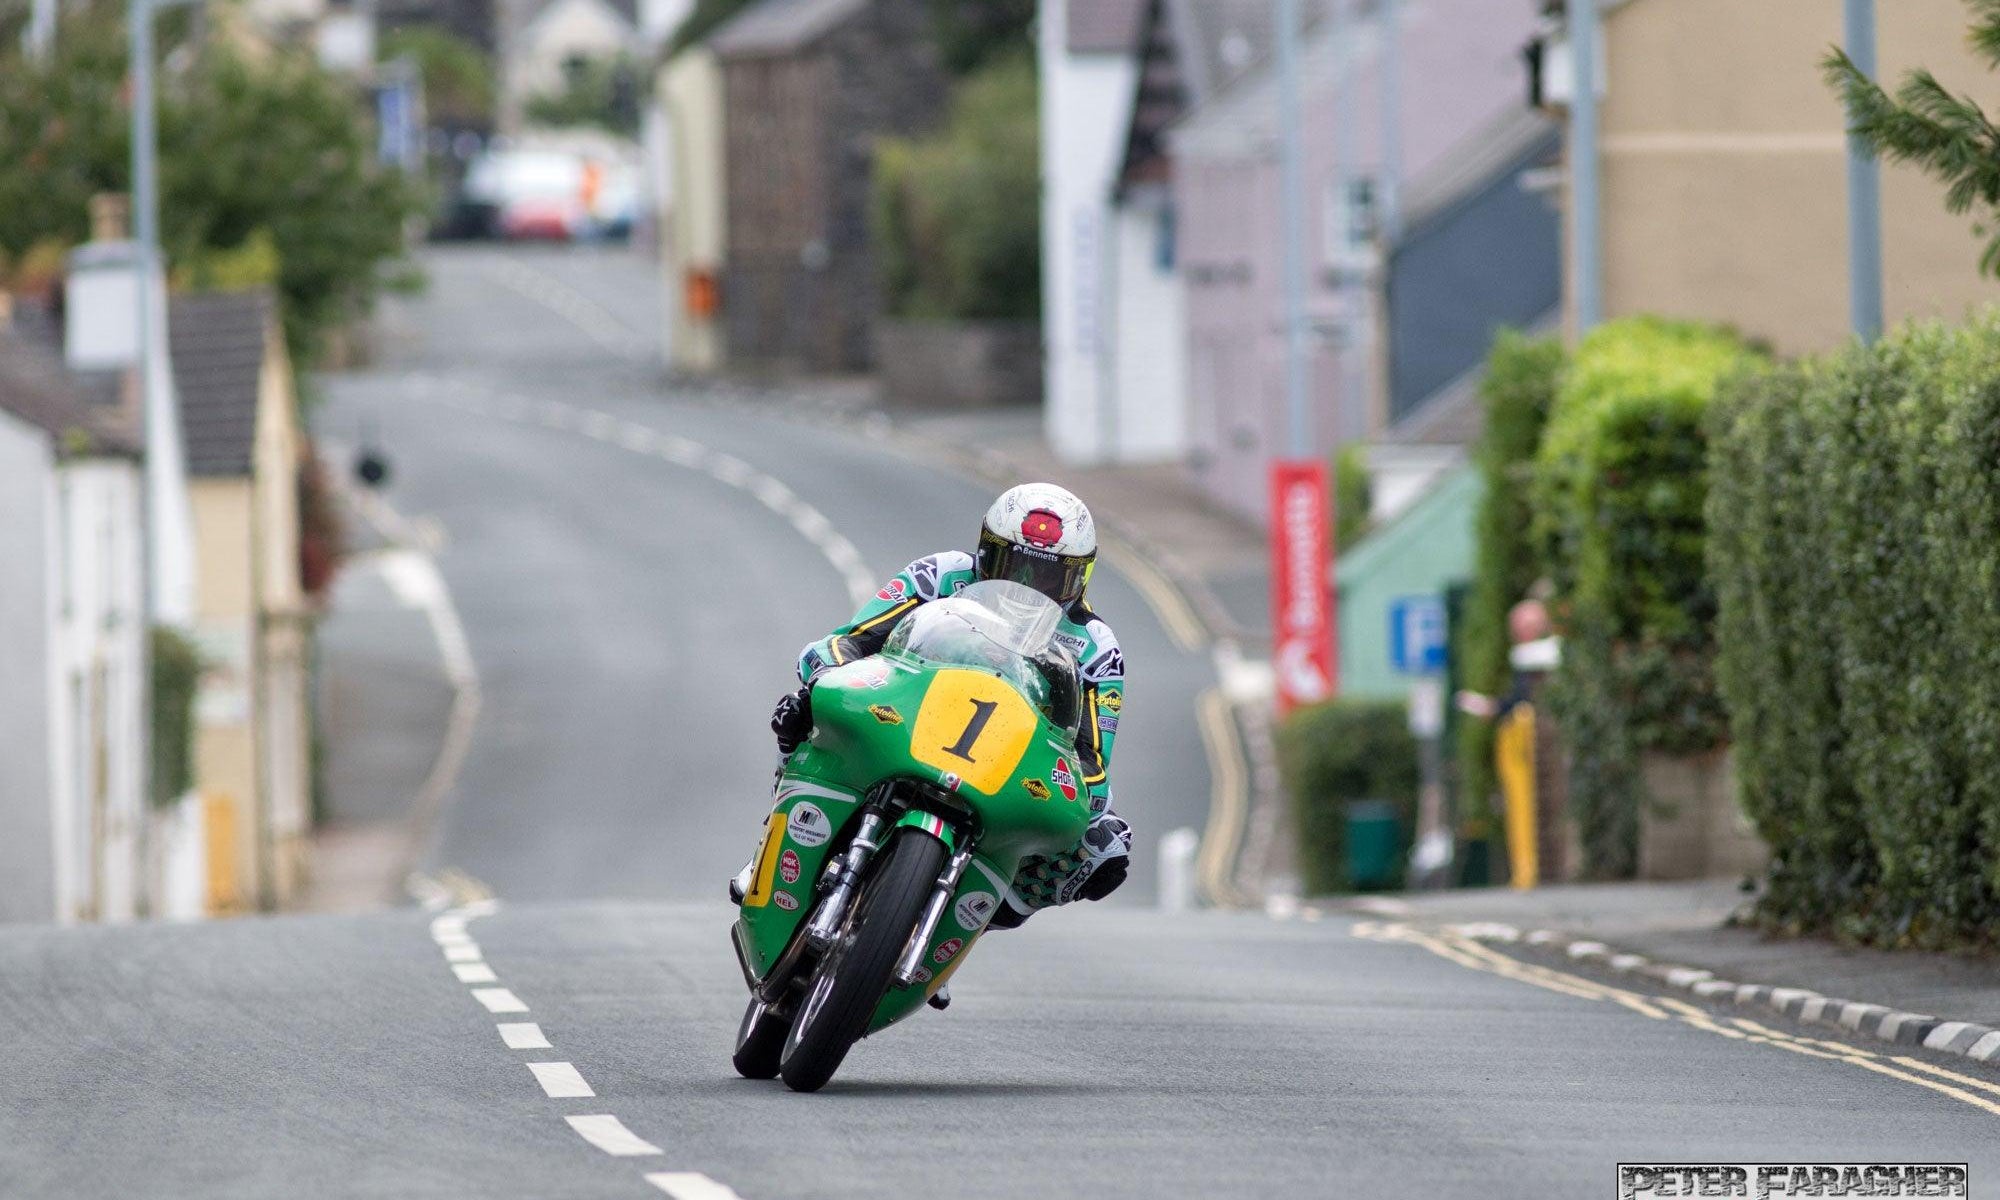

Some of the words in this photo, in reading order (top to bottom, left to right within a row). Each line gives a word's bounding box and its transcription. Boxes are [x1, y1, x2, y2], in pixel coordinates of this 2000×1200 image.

[1022, 547, 1059, 563] Bennetts
[869, 704, 902, 725] Putoline
[941, 698, 998, 764] 1
[775, 895, 795, 909] HEL
